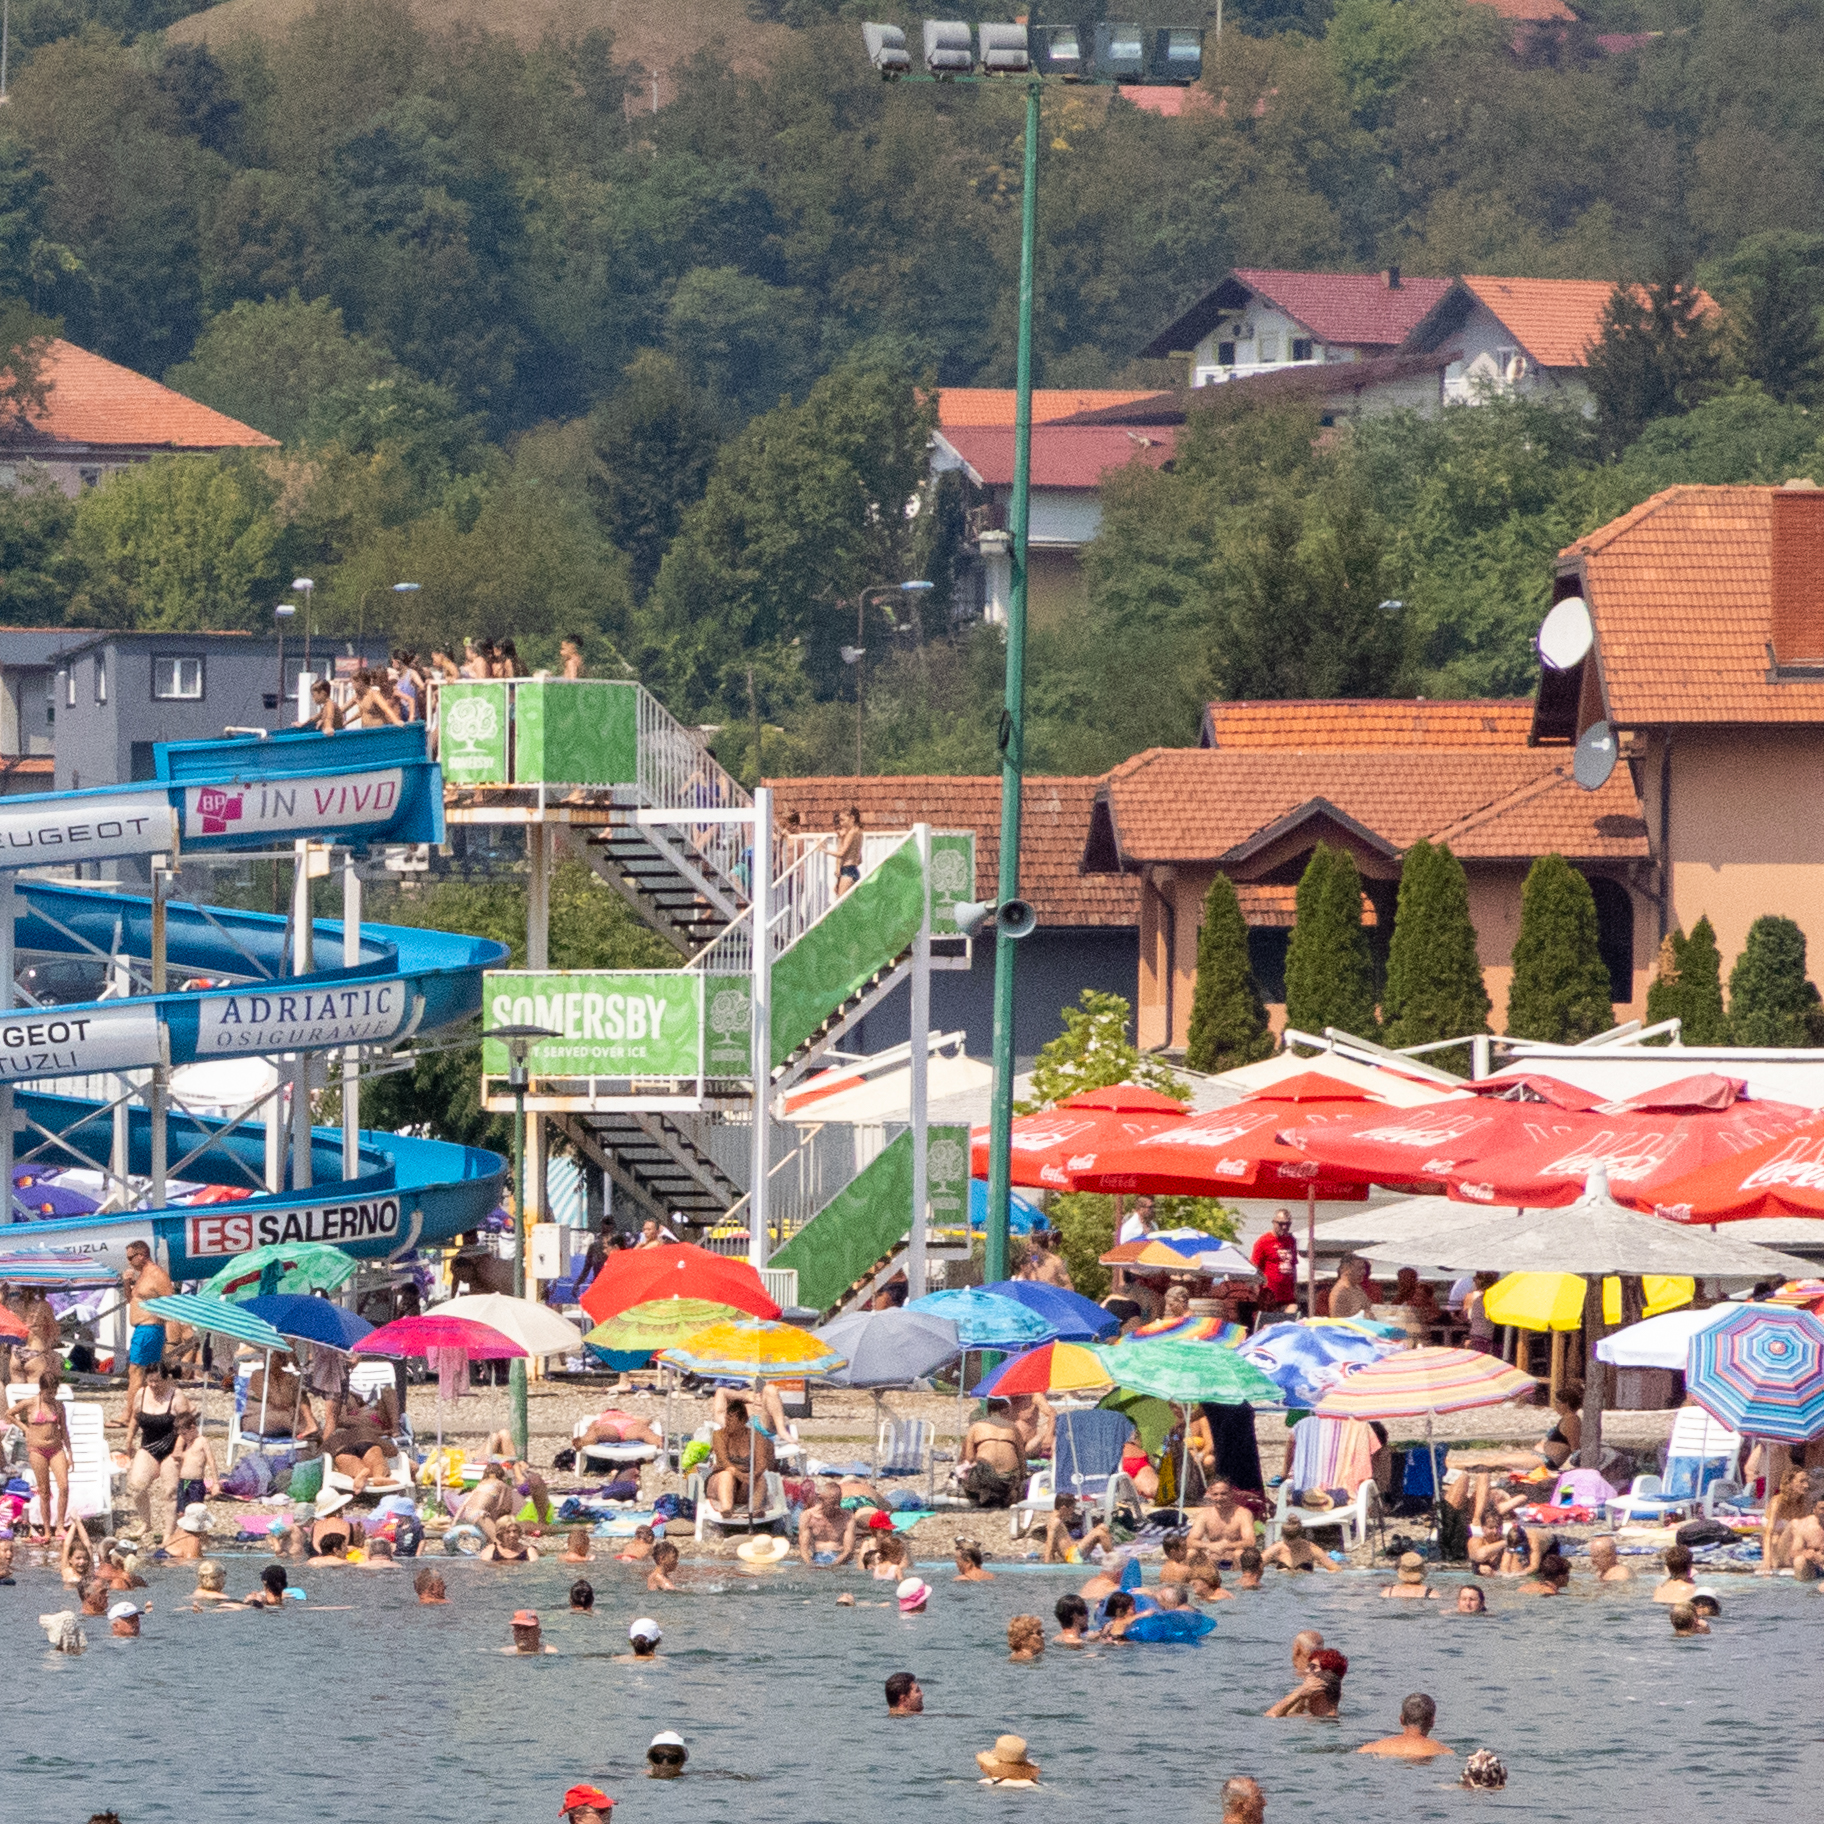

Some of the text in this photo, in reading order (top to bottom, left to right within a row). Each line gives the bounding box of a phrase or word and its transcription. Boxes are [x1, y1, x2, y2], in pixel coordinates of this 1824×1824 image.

[314, 781, 396, 814] VIVO
[219, 987, 392, 1024] ADRIATIC
[491, 993, 667, 1040] SOMERSBY
[592, 1046, 625, 1058] OVER
[199, 1199, 398, 1254] ES SALERNO
